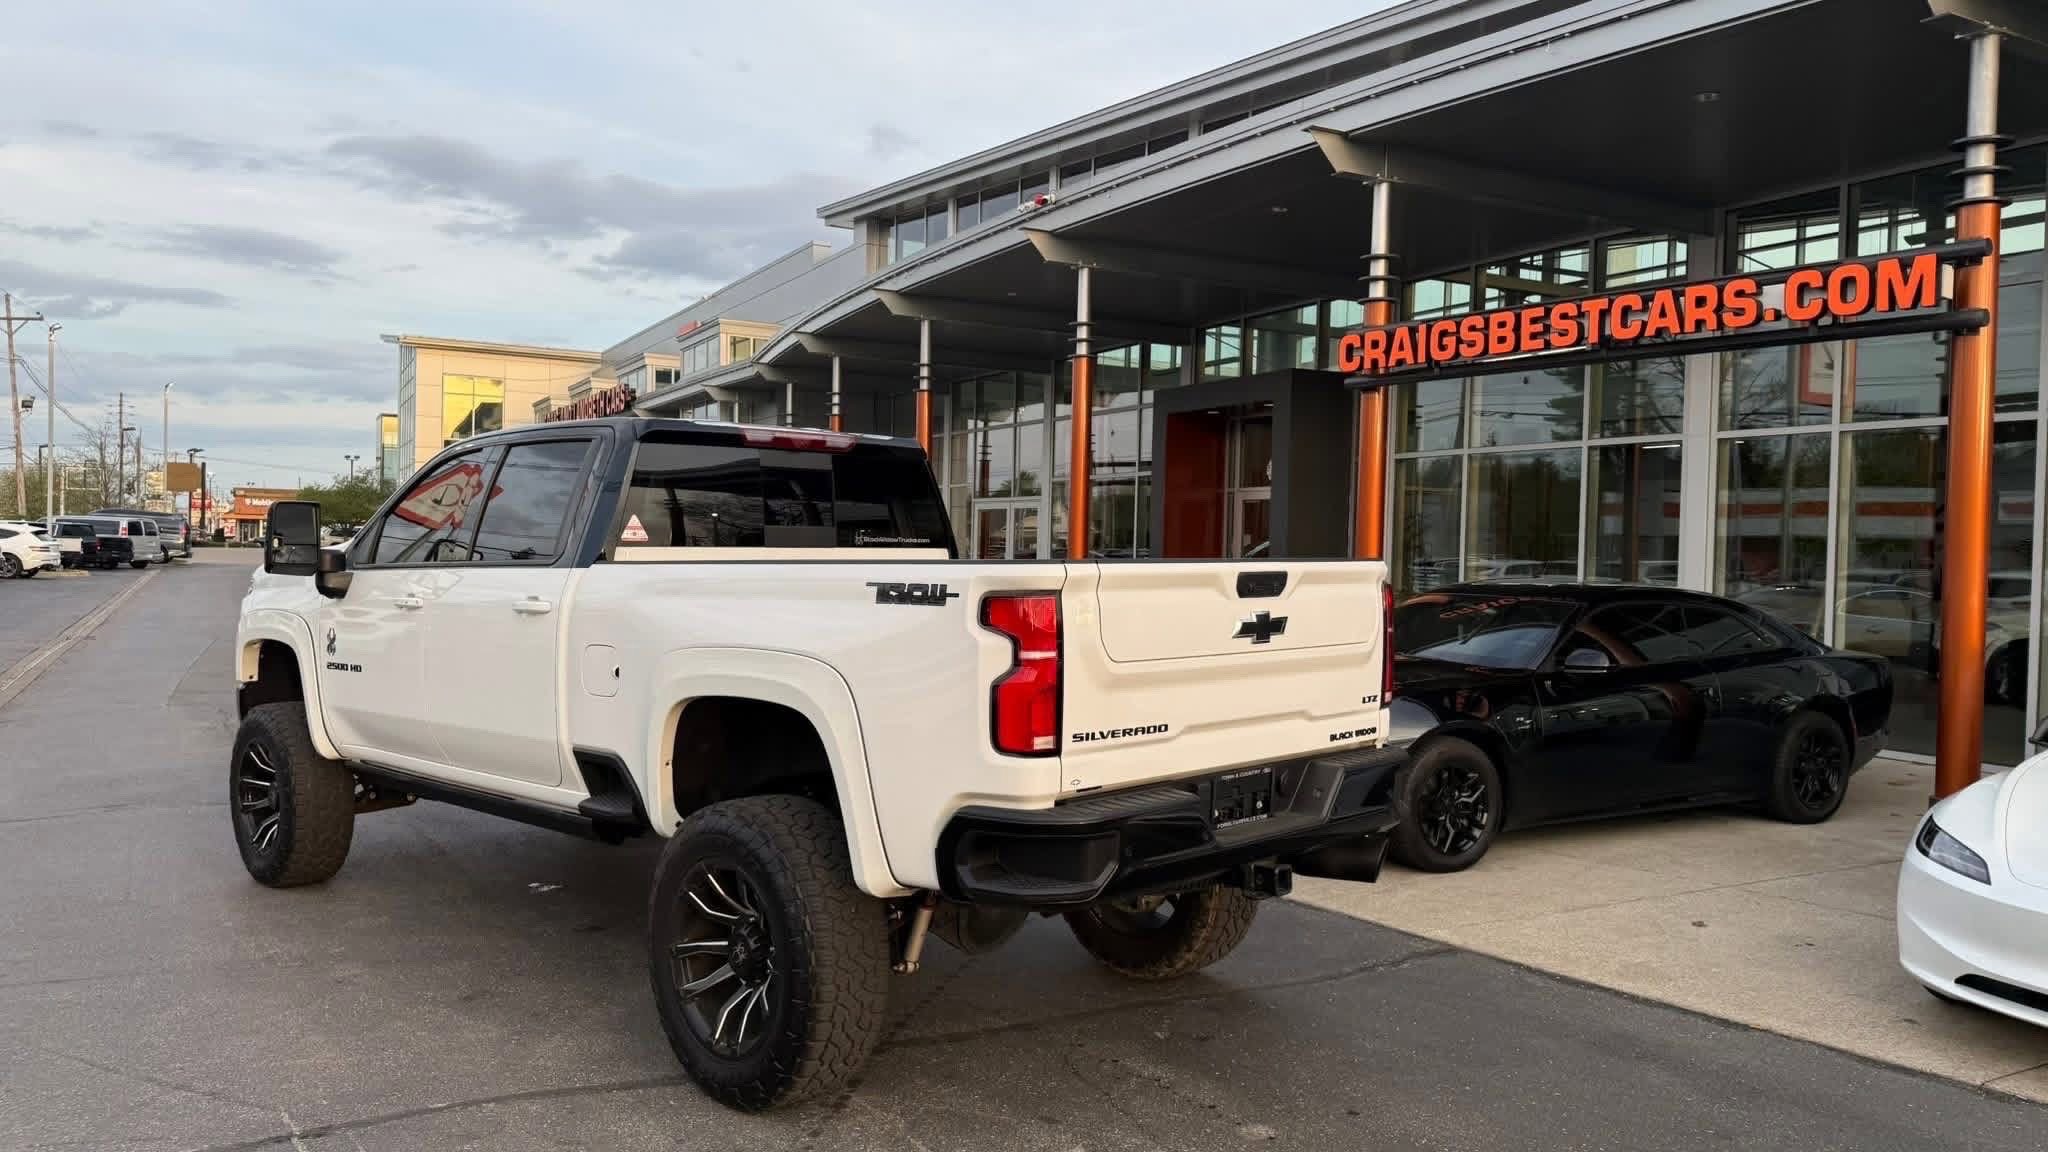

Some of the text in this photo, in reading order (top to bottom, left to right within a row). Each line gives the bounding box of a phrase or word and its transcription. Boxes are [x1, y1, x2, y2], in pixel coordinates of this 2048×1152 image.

[1338, 253, 1938, 373] CRAIGSBESTCARS.COM
[326, 661, 362, 673] 2500 HD
[1362, 695, 1378, 704] LTZ
[1071, 724, 1168, 743] SILVERADO
[1329, 726, 1377, 742] BLACK WIDOW
